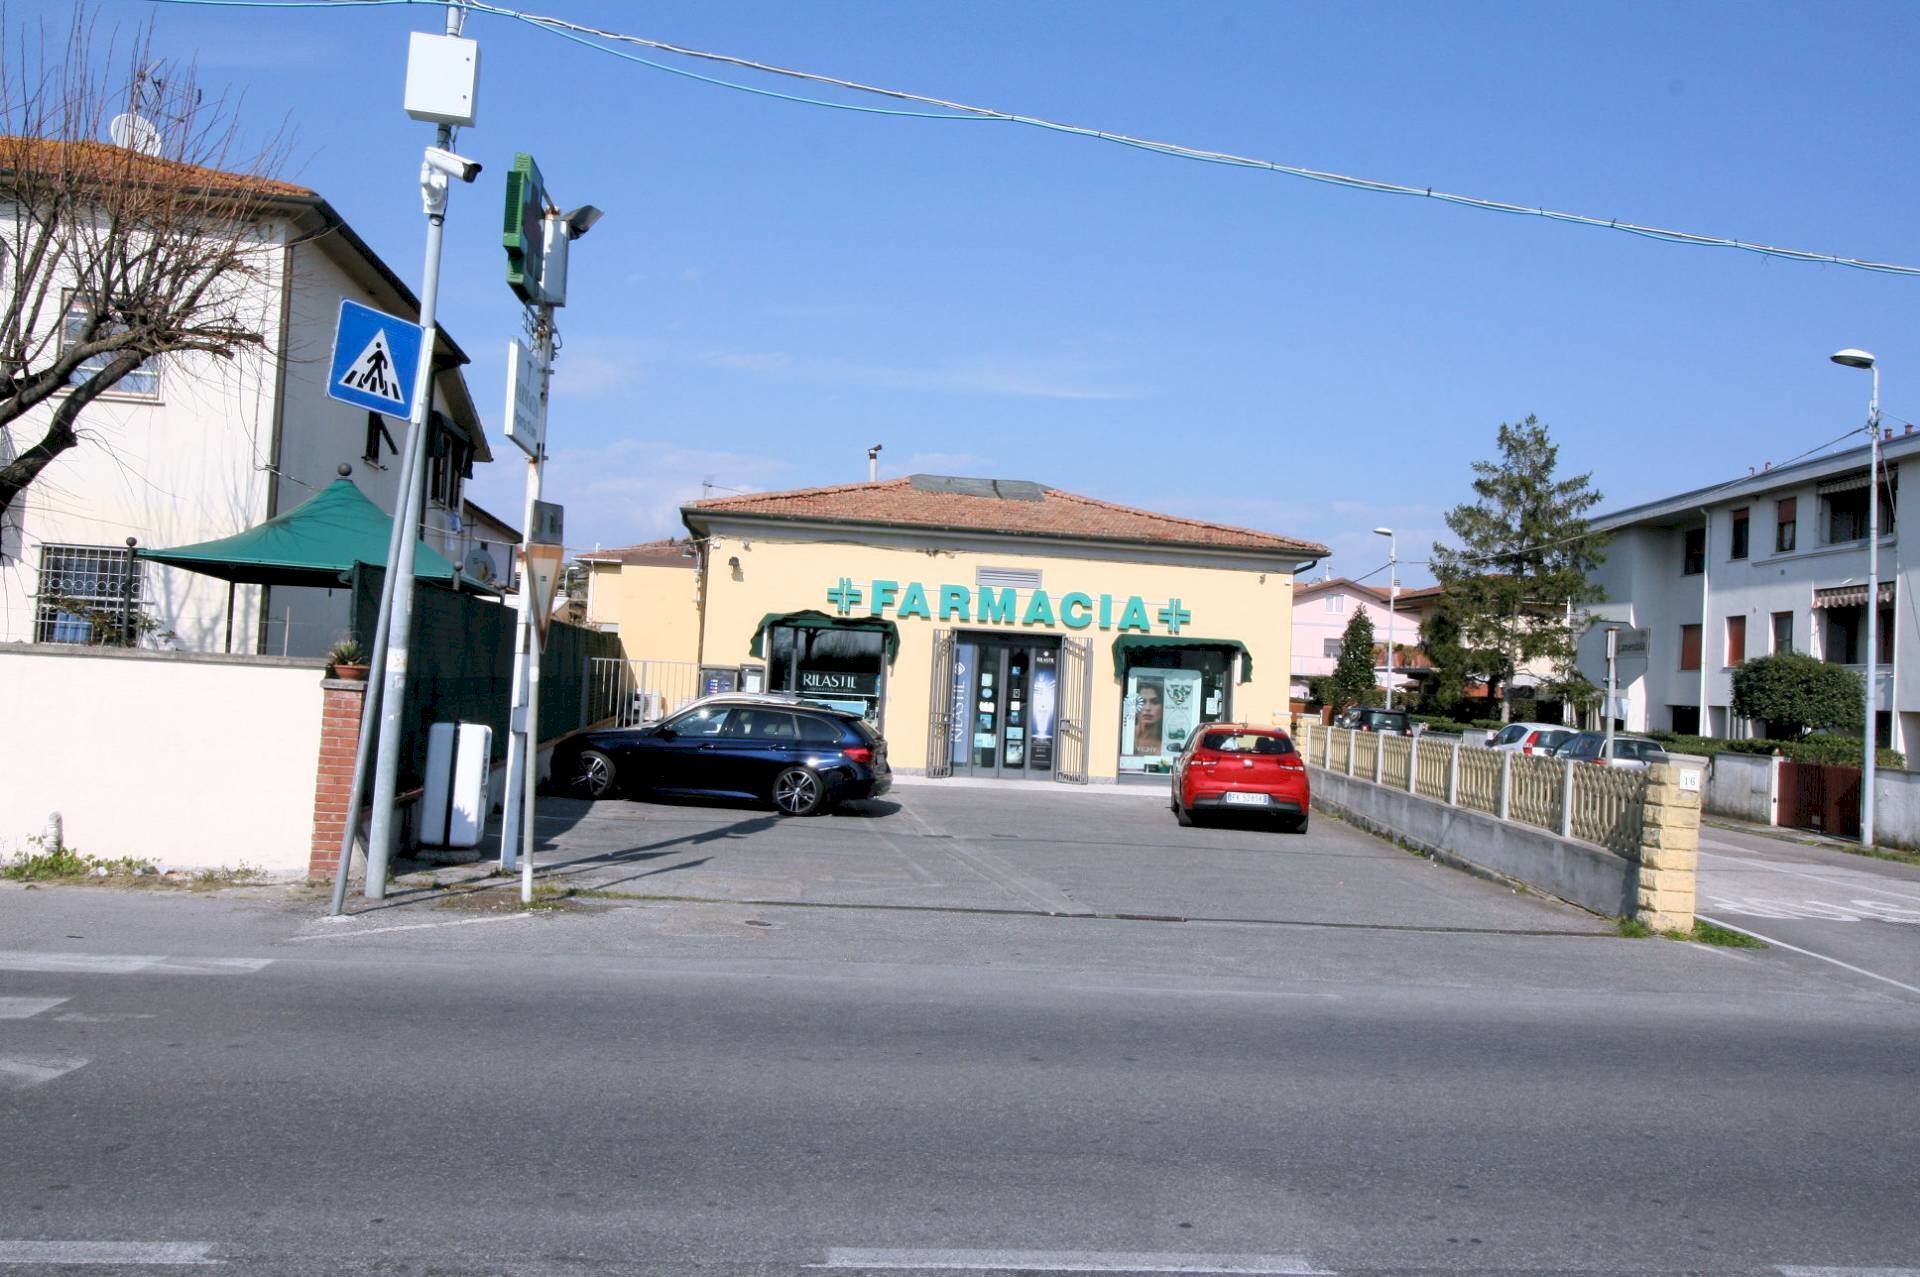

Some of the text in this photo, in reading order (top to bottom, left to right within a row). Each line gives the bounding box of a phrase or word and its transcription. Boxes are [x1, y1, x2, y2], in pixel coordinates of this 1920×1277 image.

[870, 579, 1151, 632] FARMACIA
[802, 672, 857, 689] RILASTIL
[1683, 775, 1697, 787] 16
